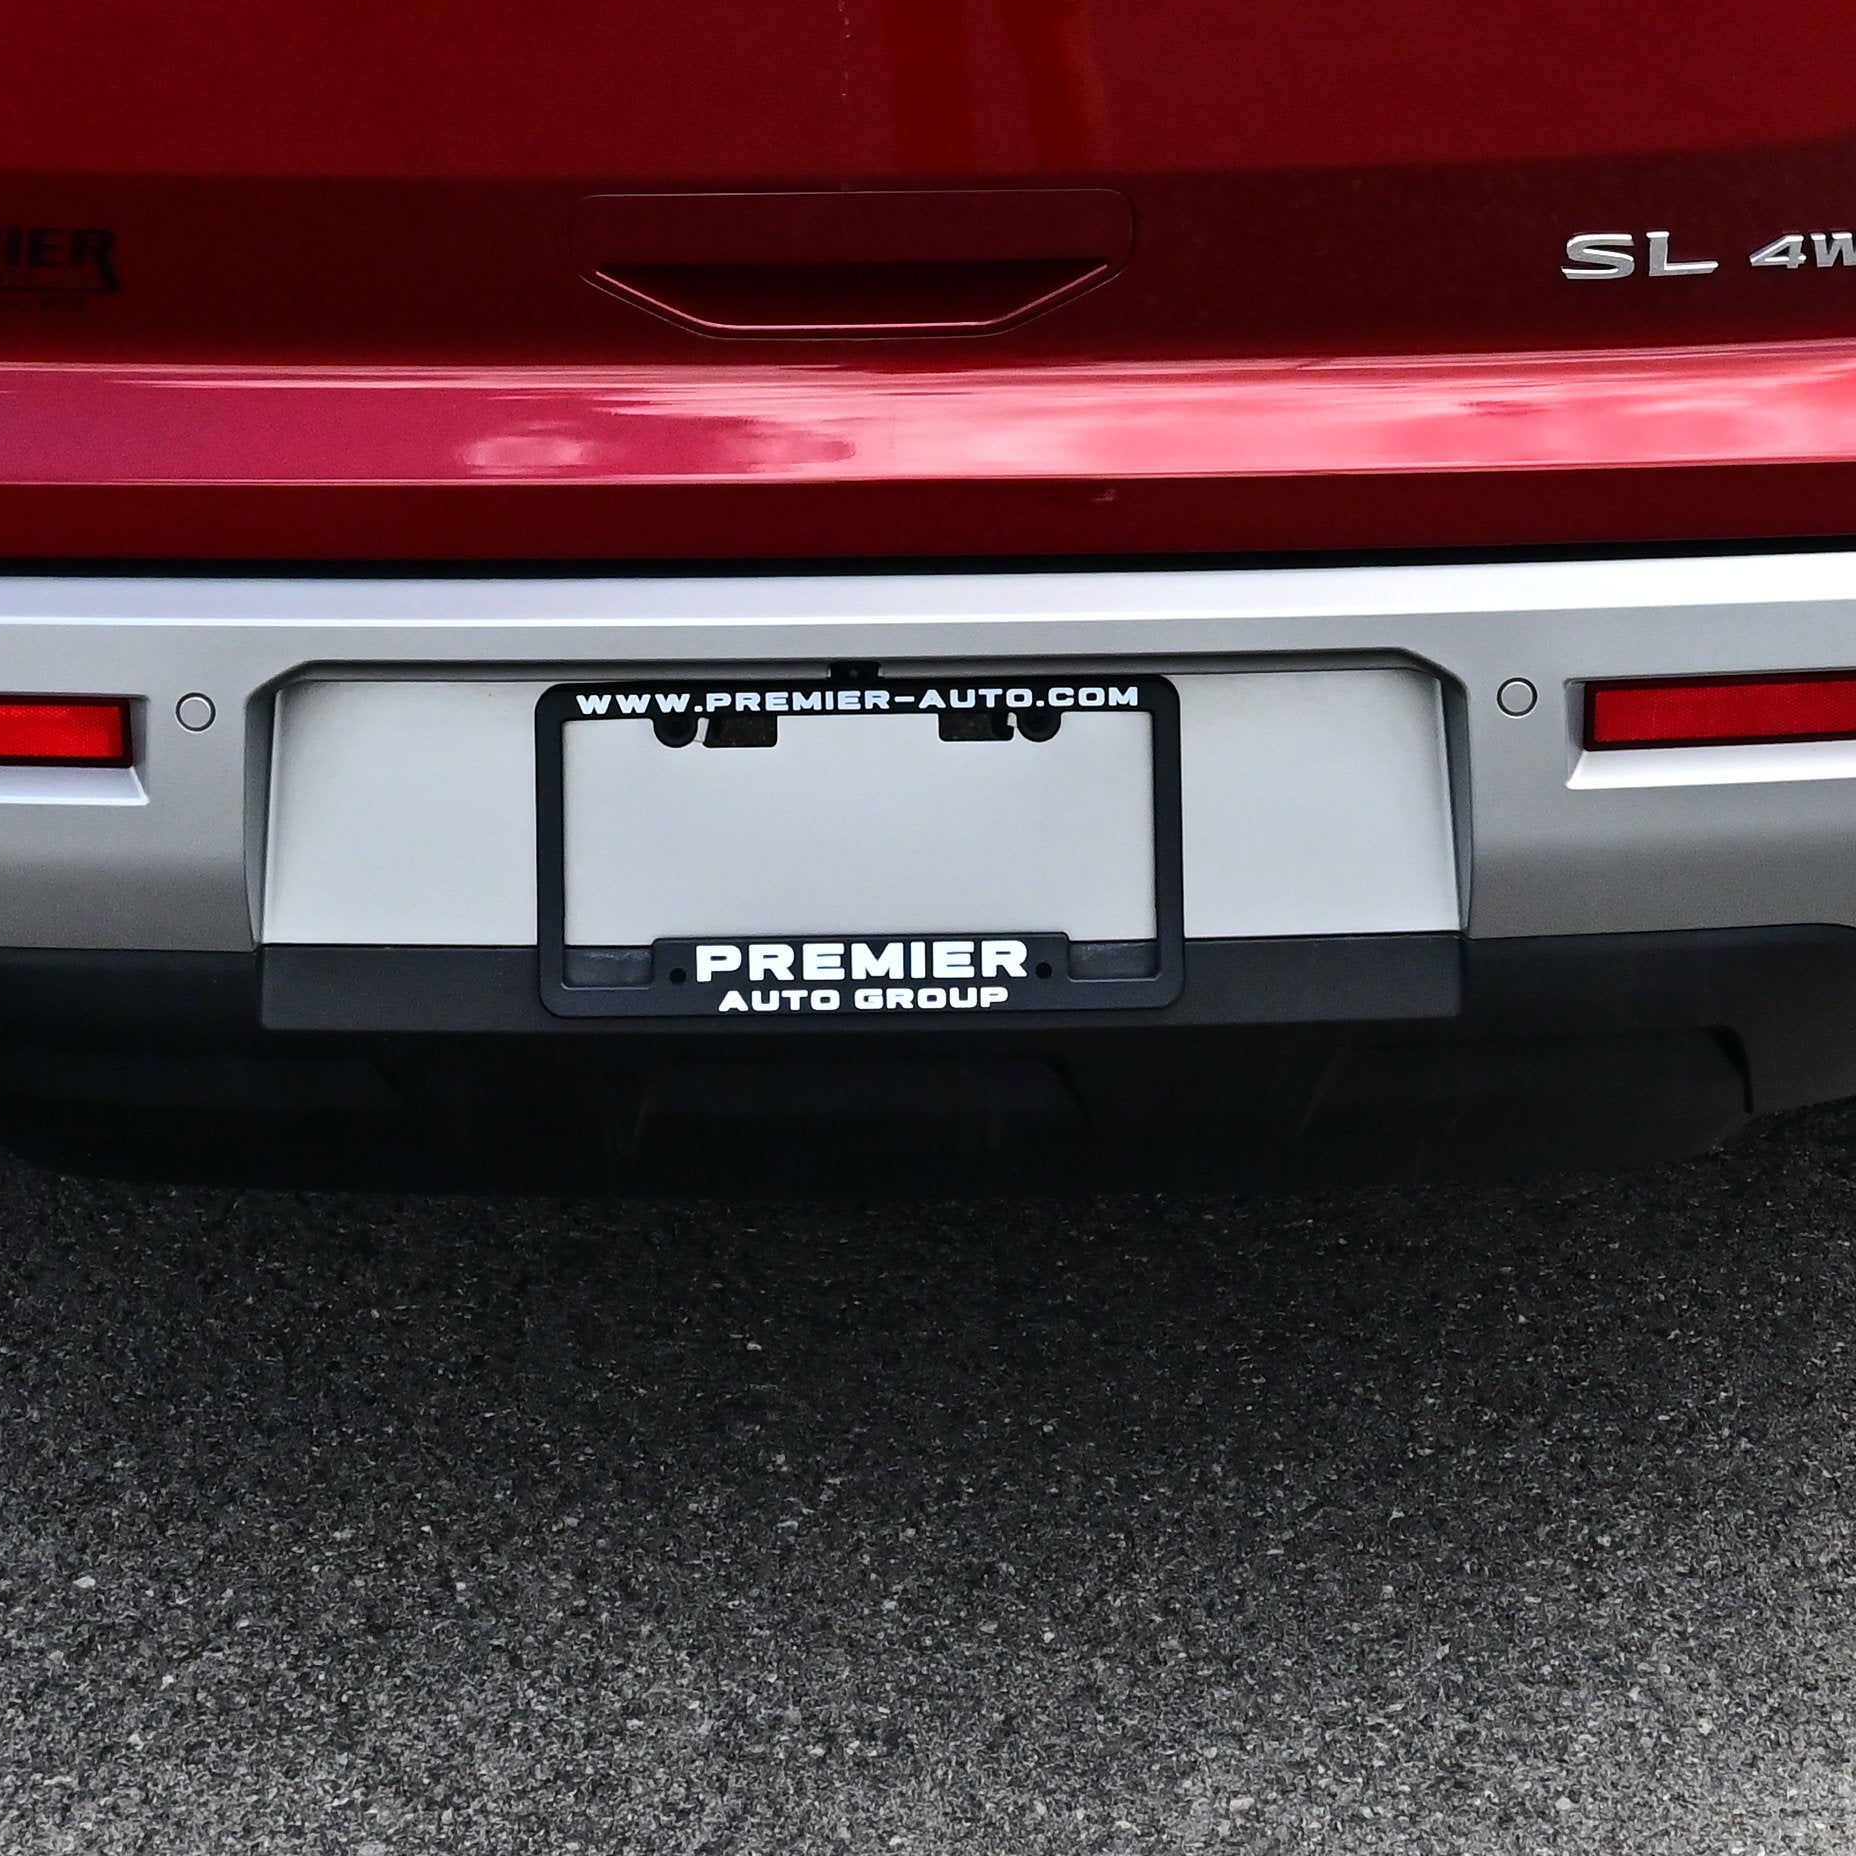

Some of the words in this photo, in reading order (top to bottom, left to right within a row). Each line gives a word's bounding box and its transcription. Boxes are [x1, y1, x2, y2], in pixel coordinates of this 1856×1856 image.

[1560, 230, 1720, 279] SL
[576, 687, 1138, 715] WWW.PREMIER-AUTO.COM
[695, 940, 1028, 982] PREMIER
[718, 988, 841, 1012] AUTO
[854, 986, 1009, 1011] GROUP
